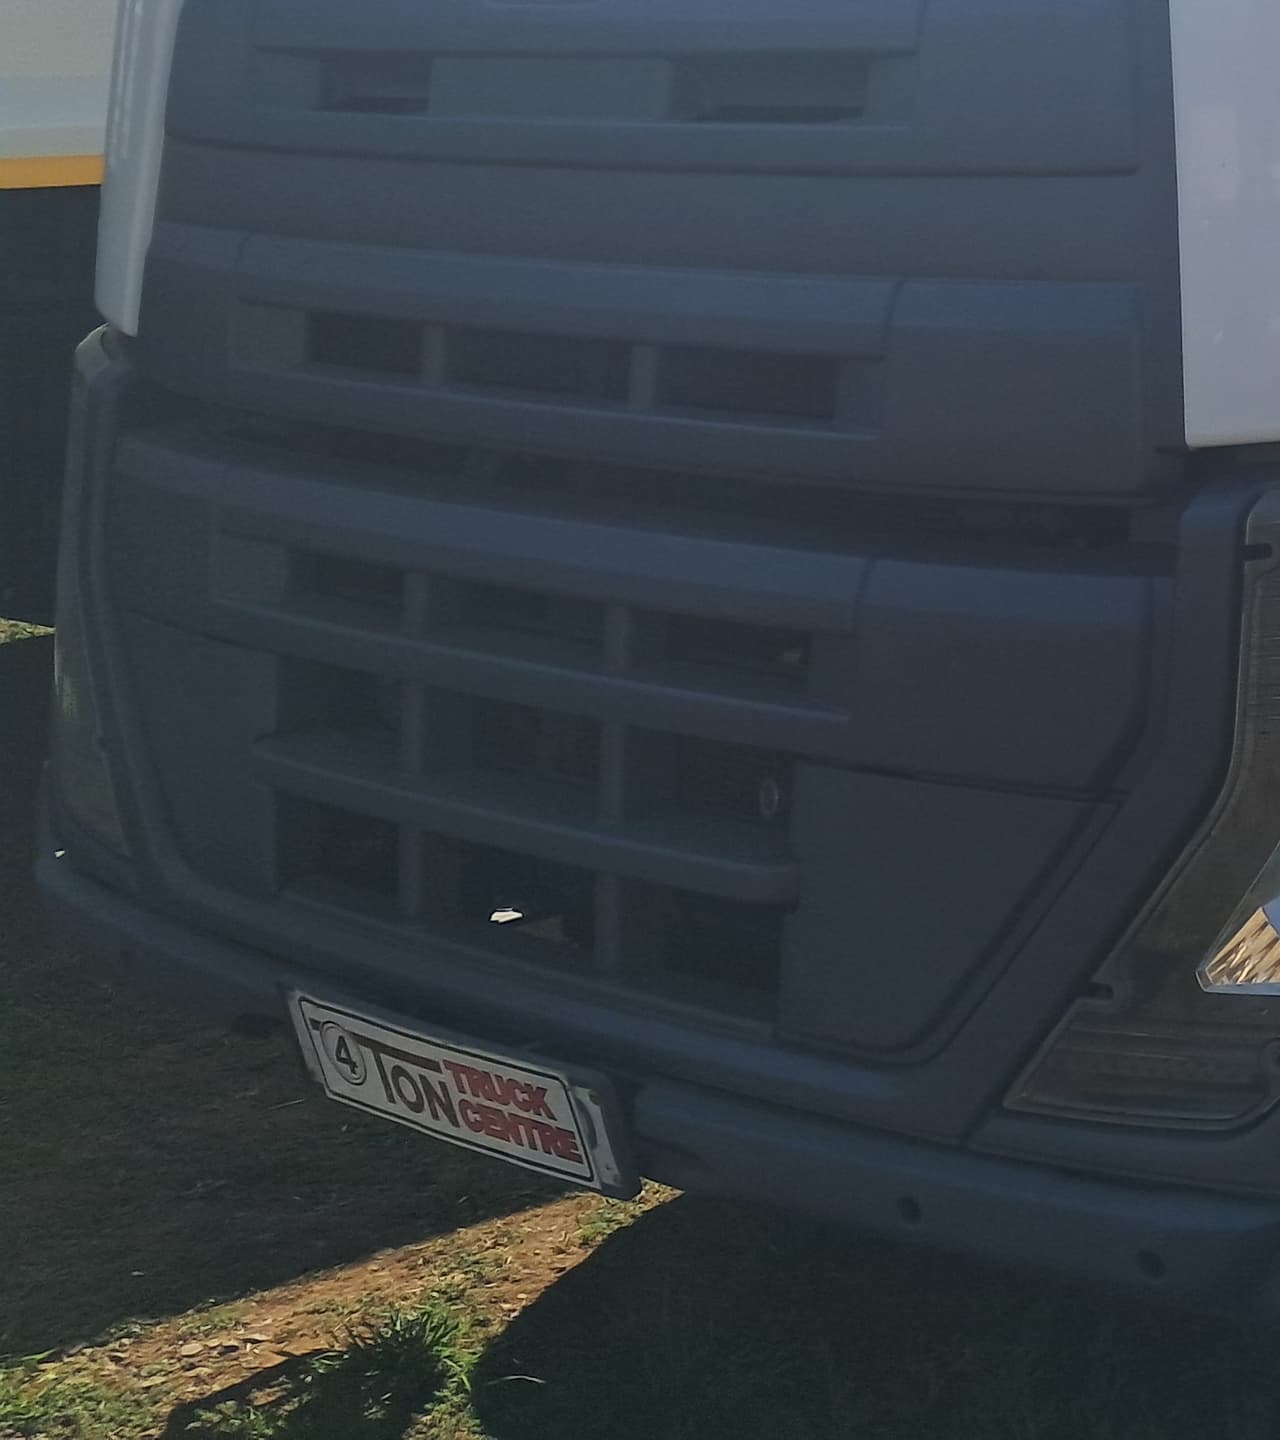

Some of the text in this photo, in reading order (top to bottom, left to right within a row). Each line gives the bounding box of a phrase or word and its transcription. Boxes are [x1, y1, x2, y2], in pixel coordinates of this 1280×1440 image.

[346, 1029, 460, 1128] TON
[443, 1059, 558, 1122] TRUCK
[458, 1098, 585, 1165] CENTRE
